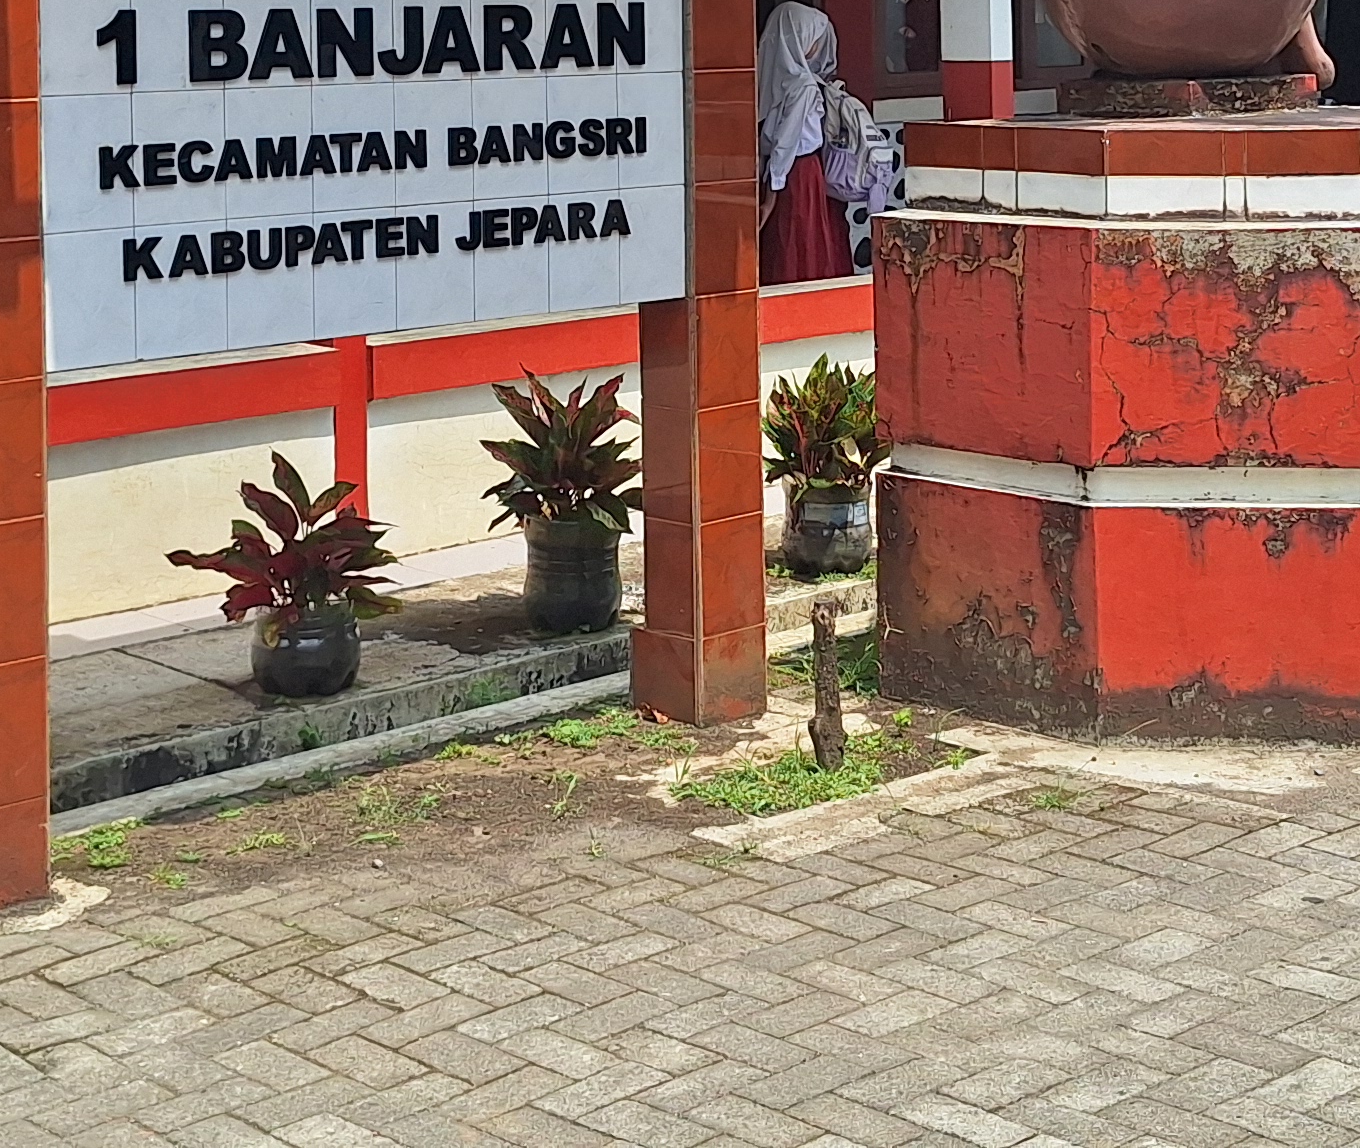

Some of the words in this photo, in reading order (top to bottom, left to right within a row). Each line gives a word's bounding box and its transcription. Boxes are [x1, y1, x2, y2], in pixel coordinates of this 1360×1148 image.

[96, 9, 138, 86] 1
[187, 1, 646, 83] BANJARAN
[98, 129, 428, 190] KECAMATAN
[447, 116, 647, 167] BANGSRI
[122, 214, 440, 283] KABUPATEN
[455, 199, 632, 252] JEPARA
